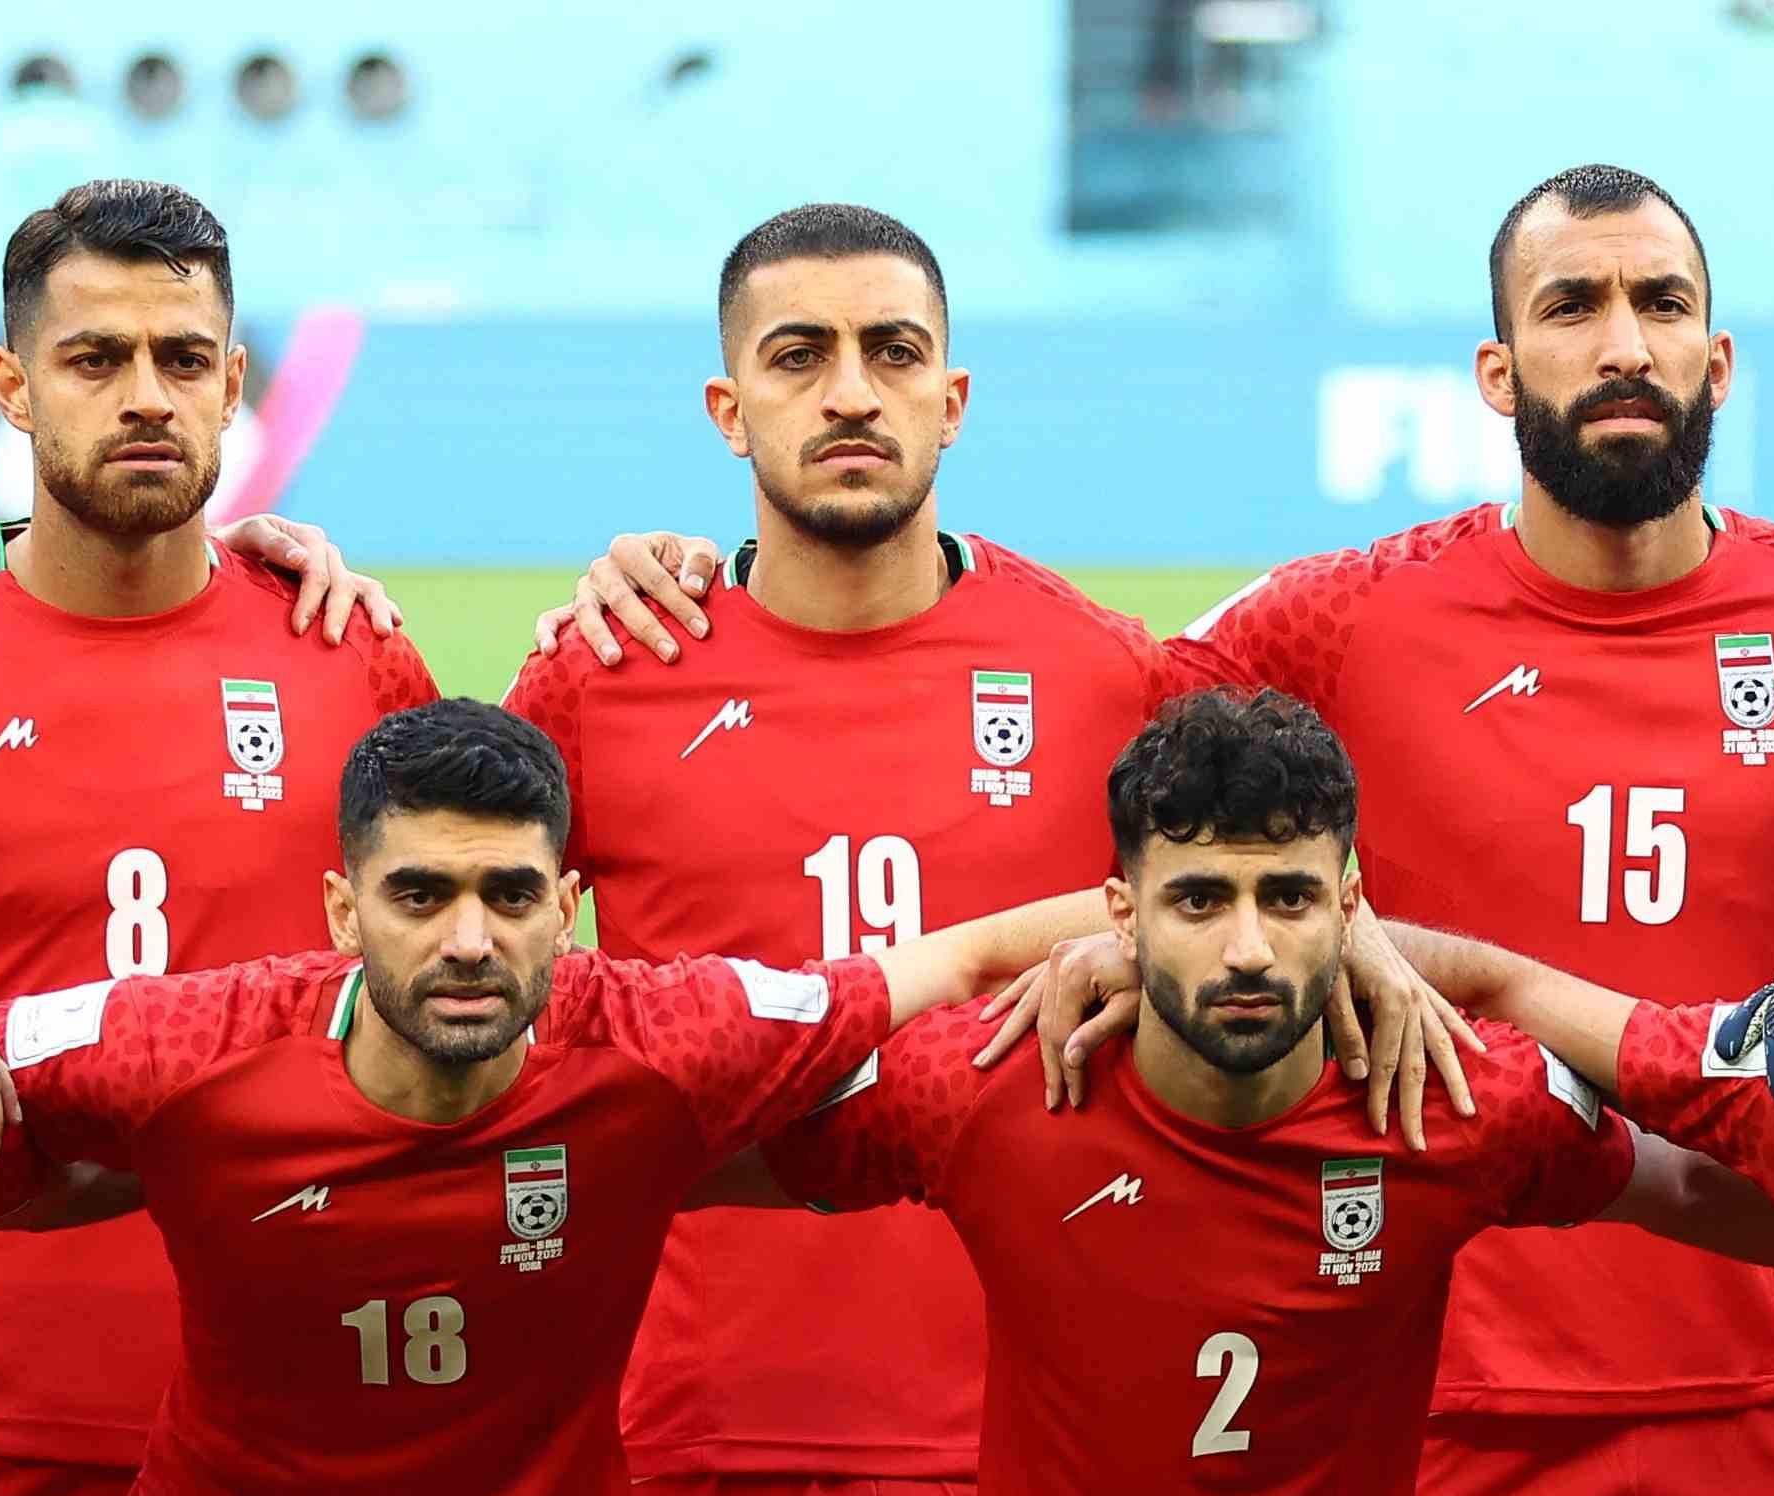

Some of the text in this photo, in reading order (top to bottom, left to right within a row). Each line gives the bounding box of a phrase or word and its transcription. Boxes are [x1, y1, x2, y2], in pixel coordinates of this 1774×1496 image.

[105, 847, 169, 979] 8
[803, 835, 922, 961] 19
[1567, 785, 1686, 924] 15
[513, 1251, 535, 1263] NOV
[536, 1248, 563, 1260] 2022
[1318, 1260, 1381, 1275] 21 NOV 2022
[341, 1296, 467, 1385] 18
[1191, 1331, 1260, 1458] 2
